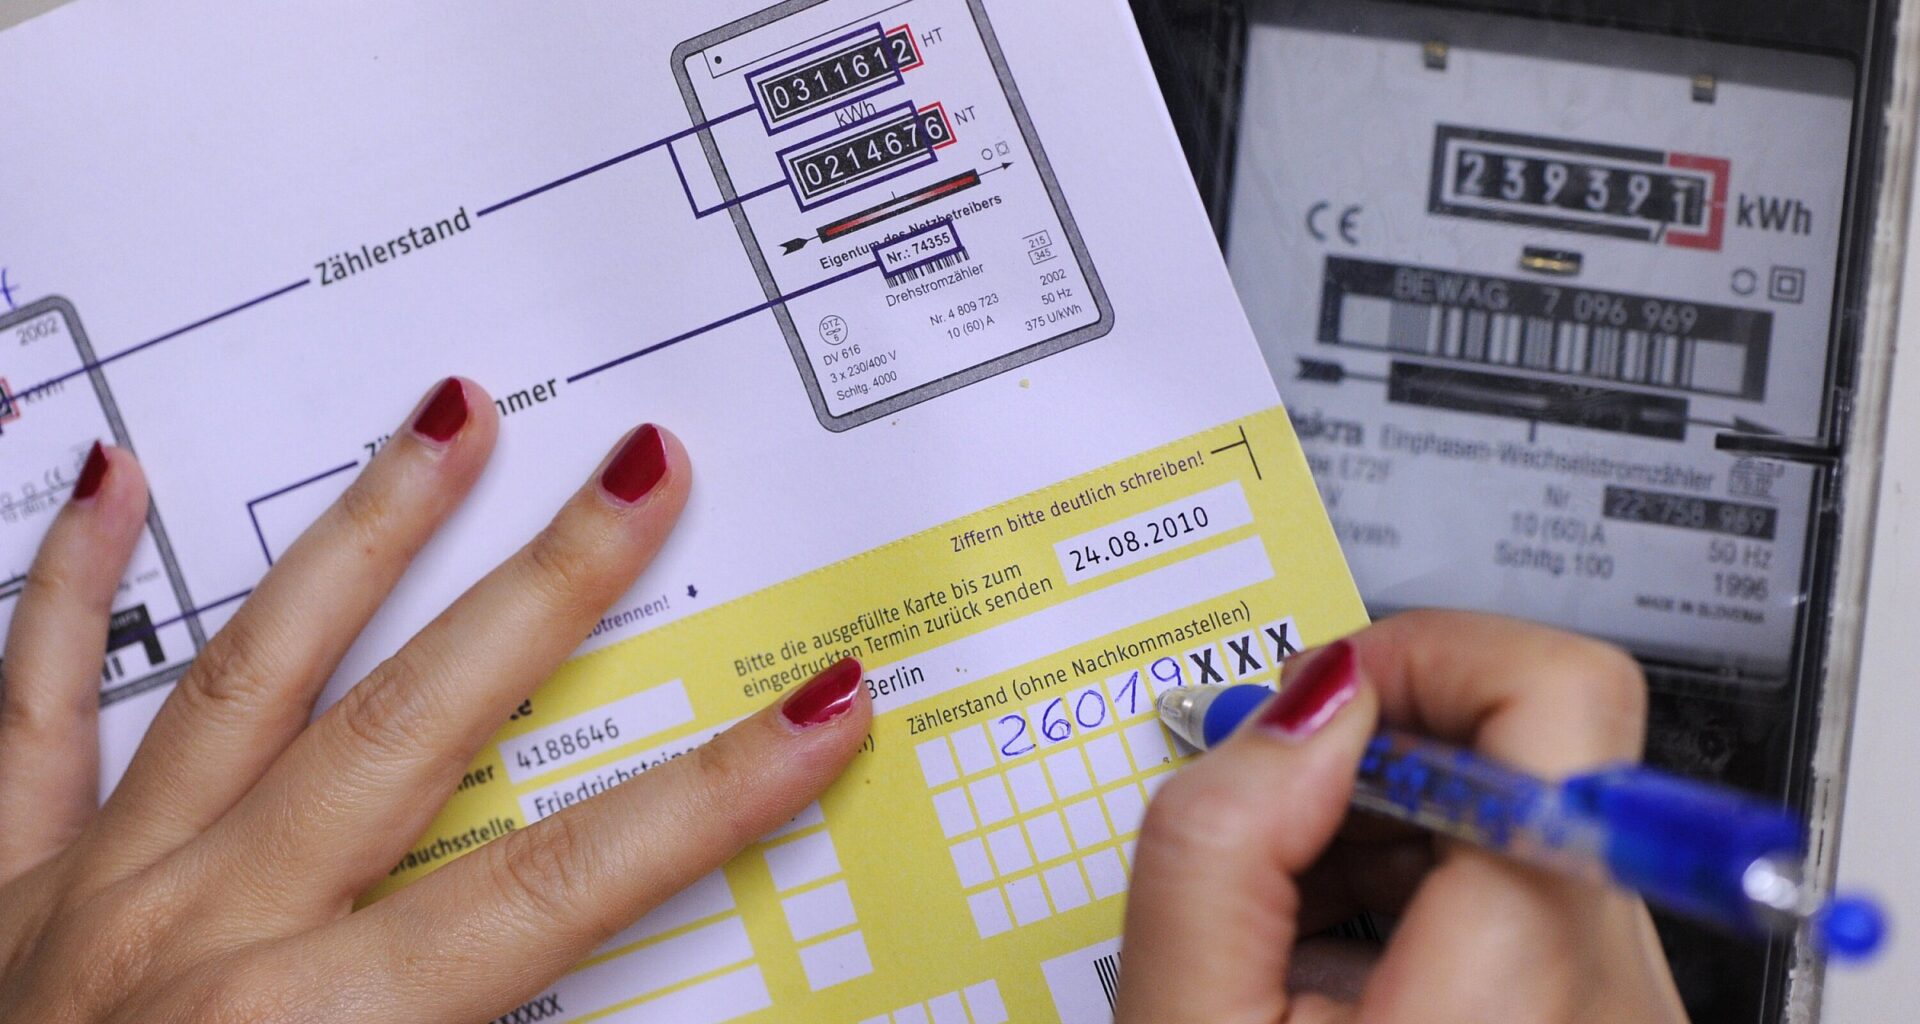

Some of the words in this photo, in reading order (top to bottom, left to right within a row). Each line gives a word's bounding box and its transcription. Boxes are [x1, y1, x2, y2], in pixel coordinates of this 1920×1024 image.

[921, 27, 942, 47] HT
[773, 39, 911, 109] 0311612
[835, 101, 877, 128] kWh
[954, 106, 977, 126] NT
[805, 117, 943, 186] 0214676
[1737, 193, 1814, 237] kWh
[315, 206, 472, 286] Zählerstand
[819, 238, 880, 270] Eigentum
[911, 232, 951, 256] 74355
[1028, 235, 1046, 249] 215
[1034, 248, 1052, 262] 345
[885, 263, 985, 308] Drehstromzähler
[1039, 268, 1067, 287] 2002
[930, 314, 946, 327] Nr.
[948, 309, 956, 320] 4
[957, 301, 978, 317] 809
[979, 293, 999, 309] 723
[1041, 293, 1055, 306] 50
[1057, 287, 1073, 302] Hz
[1394, 267, 1508, 311] BEWAG
[1541, 287, 1559, 315] 7
[1642, 301, 1698, 333] 969
[822, 317, 841, 331] DTZ
[947, 327, 962, 340] 10
[963, 317, 986, 338] (60)
[986, 315, 996, 327] A
[1025, 315, 1047, 332] 375
[1047, 304, 1083, 324] U/kWh
[833, 334, 840, 342] 6
[823, 351, 839, 366] DV
[841, 343, 862, 359] 616
[830, 372, 838, 384] 3
[847, 354, 888, 377] 230/400
[888, 350, 897, 361] V
[836, 383, 872, 401] Schltg.
[872, 370, 897, 387] 4000
[950, 524, 1004, 553] Ziffern
[1007, 508, 1046, 534] bitte
[1050, 482, 1116, 518] deutlich
[1120, 450, 1205, 493] schreiben!
[1069, 505, 1210, 572] 24.08.2010
[733, 652, 776, 678] Bitte
[780, 639, 808, 661] die
[812, 606, 900, 643] ausgefüllte
[903, 588, 948, 616] Karte
[950, 576, 979, 600] bis
[982, 561, 1023, 590] zum
[864, 622, 922, 655] Termin
[924, 600, 982, 635] zurück
[985, 575, 1055, 613] senden
[907, 689, 1009, 737] Zählerstand
[1012, 667, 1068, 702] (ohne
[1071, 600, 1251, 678] Nachkommastellen)
[516, 717, 621, 770] 4188646
